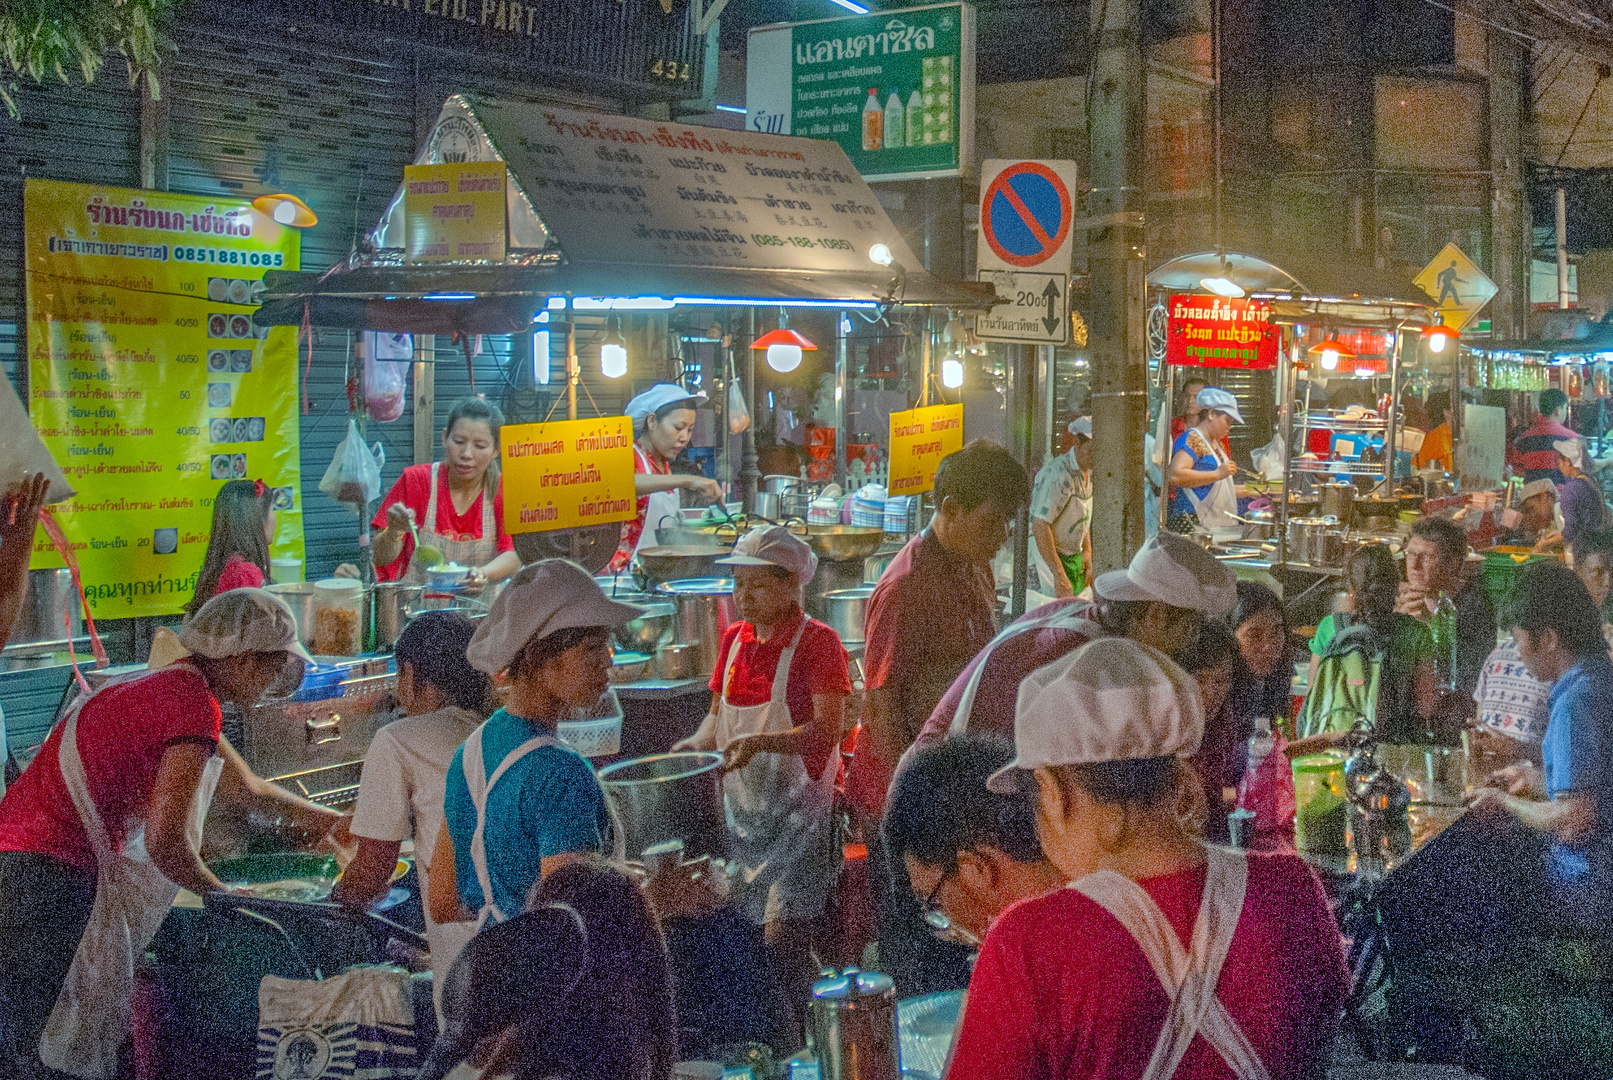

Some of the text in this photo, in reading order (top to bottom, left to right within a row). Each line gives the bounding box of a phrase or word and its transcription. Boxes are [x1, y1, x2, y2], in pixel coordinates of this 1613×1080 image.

[796, 19, 935, 65] แอนตาซิล
[651, 59, 690, 81] 434
[751, 233, 855, 252] (085-188-1085)
[174, 246, 283, 267] 0851881085
[180, 283, 195, 292] 100
[175, 318, 198, 328] 40/50
[1185, 323, 1213, 340] รังนก
[175, 355, 199, 364] 40/50
[179, 391, 190, 399] 50
[176, 426, 201, 436] 40/50
[176, 462, 202, 472] 40/50
[137, 538, 150, 547] 20
